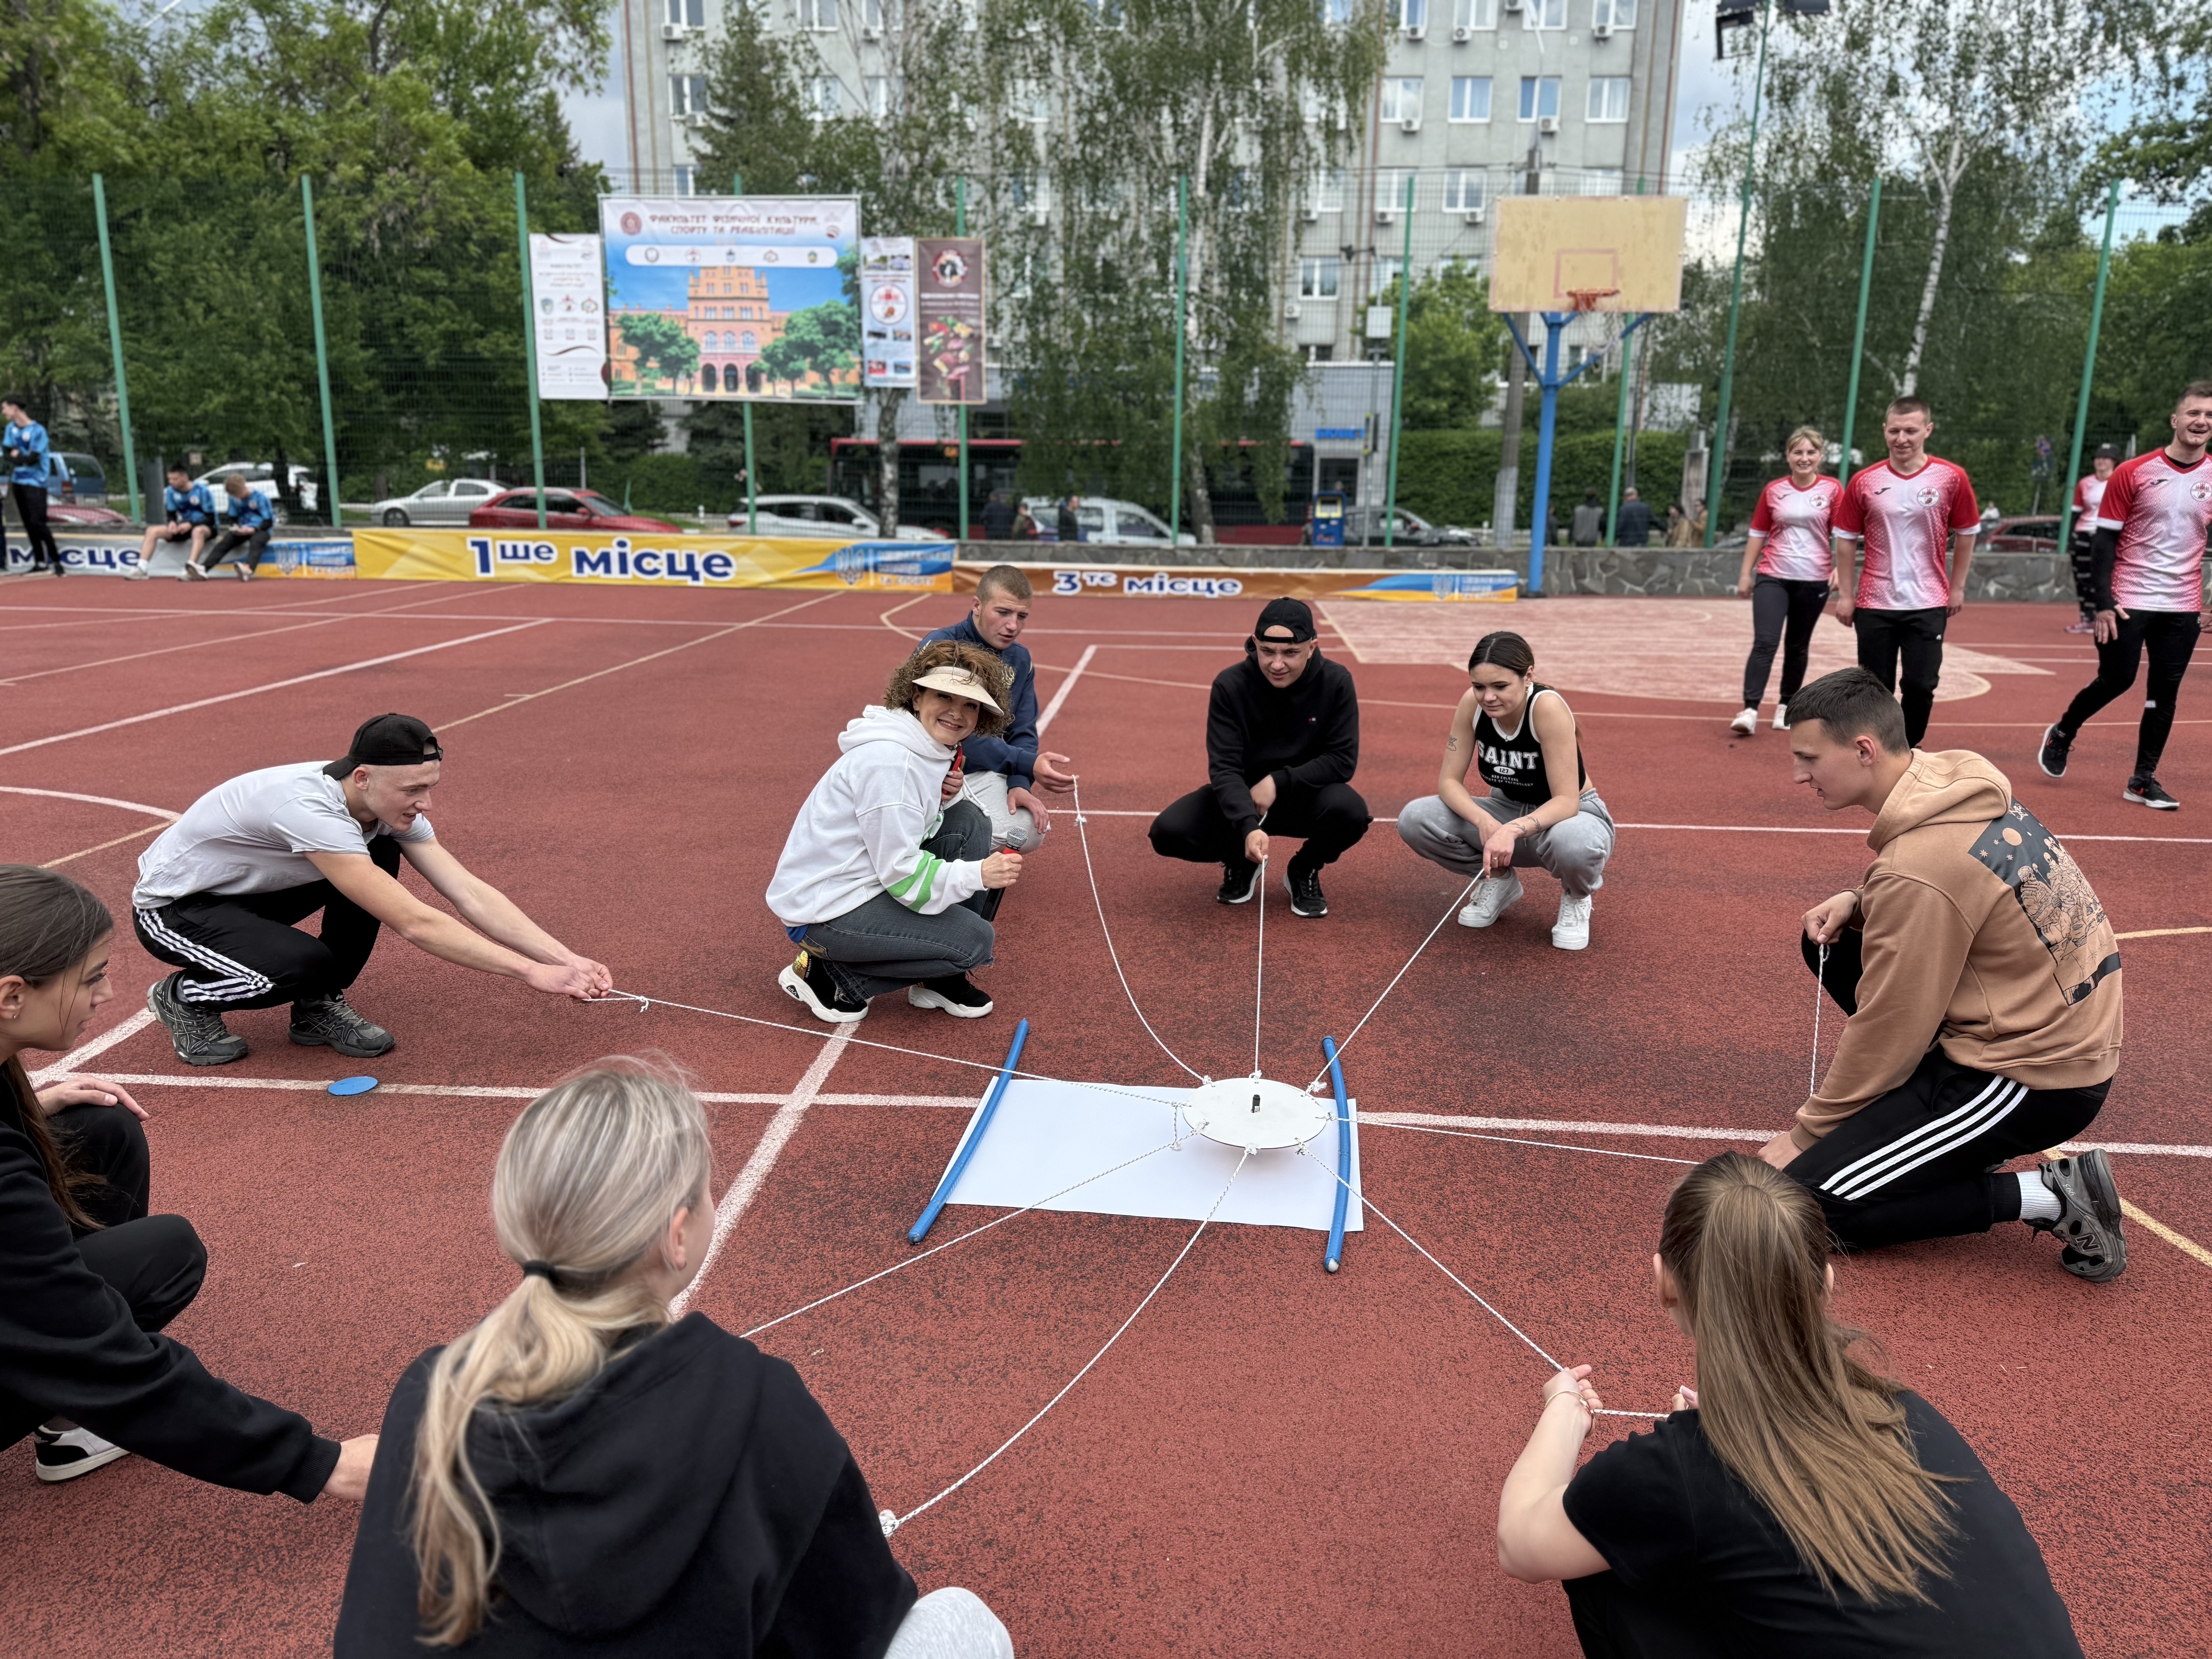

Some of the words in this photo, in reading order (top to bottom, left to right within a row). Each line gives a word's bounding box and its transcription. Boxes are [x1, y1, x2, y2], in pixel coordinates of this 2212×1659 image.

[713, 225, 724, 234] ТА
[9, 547, 140, 569] мсце
[575, 539, 733, 582] місце
[1126, 574, 1240, 595] місце
[1476, 740, 1539, 769] SAINT
[2063, 1183, 2076, 1196] 993
[2075, 1233, 2101, 1252] N
